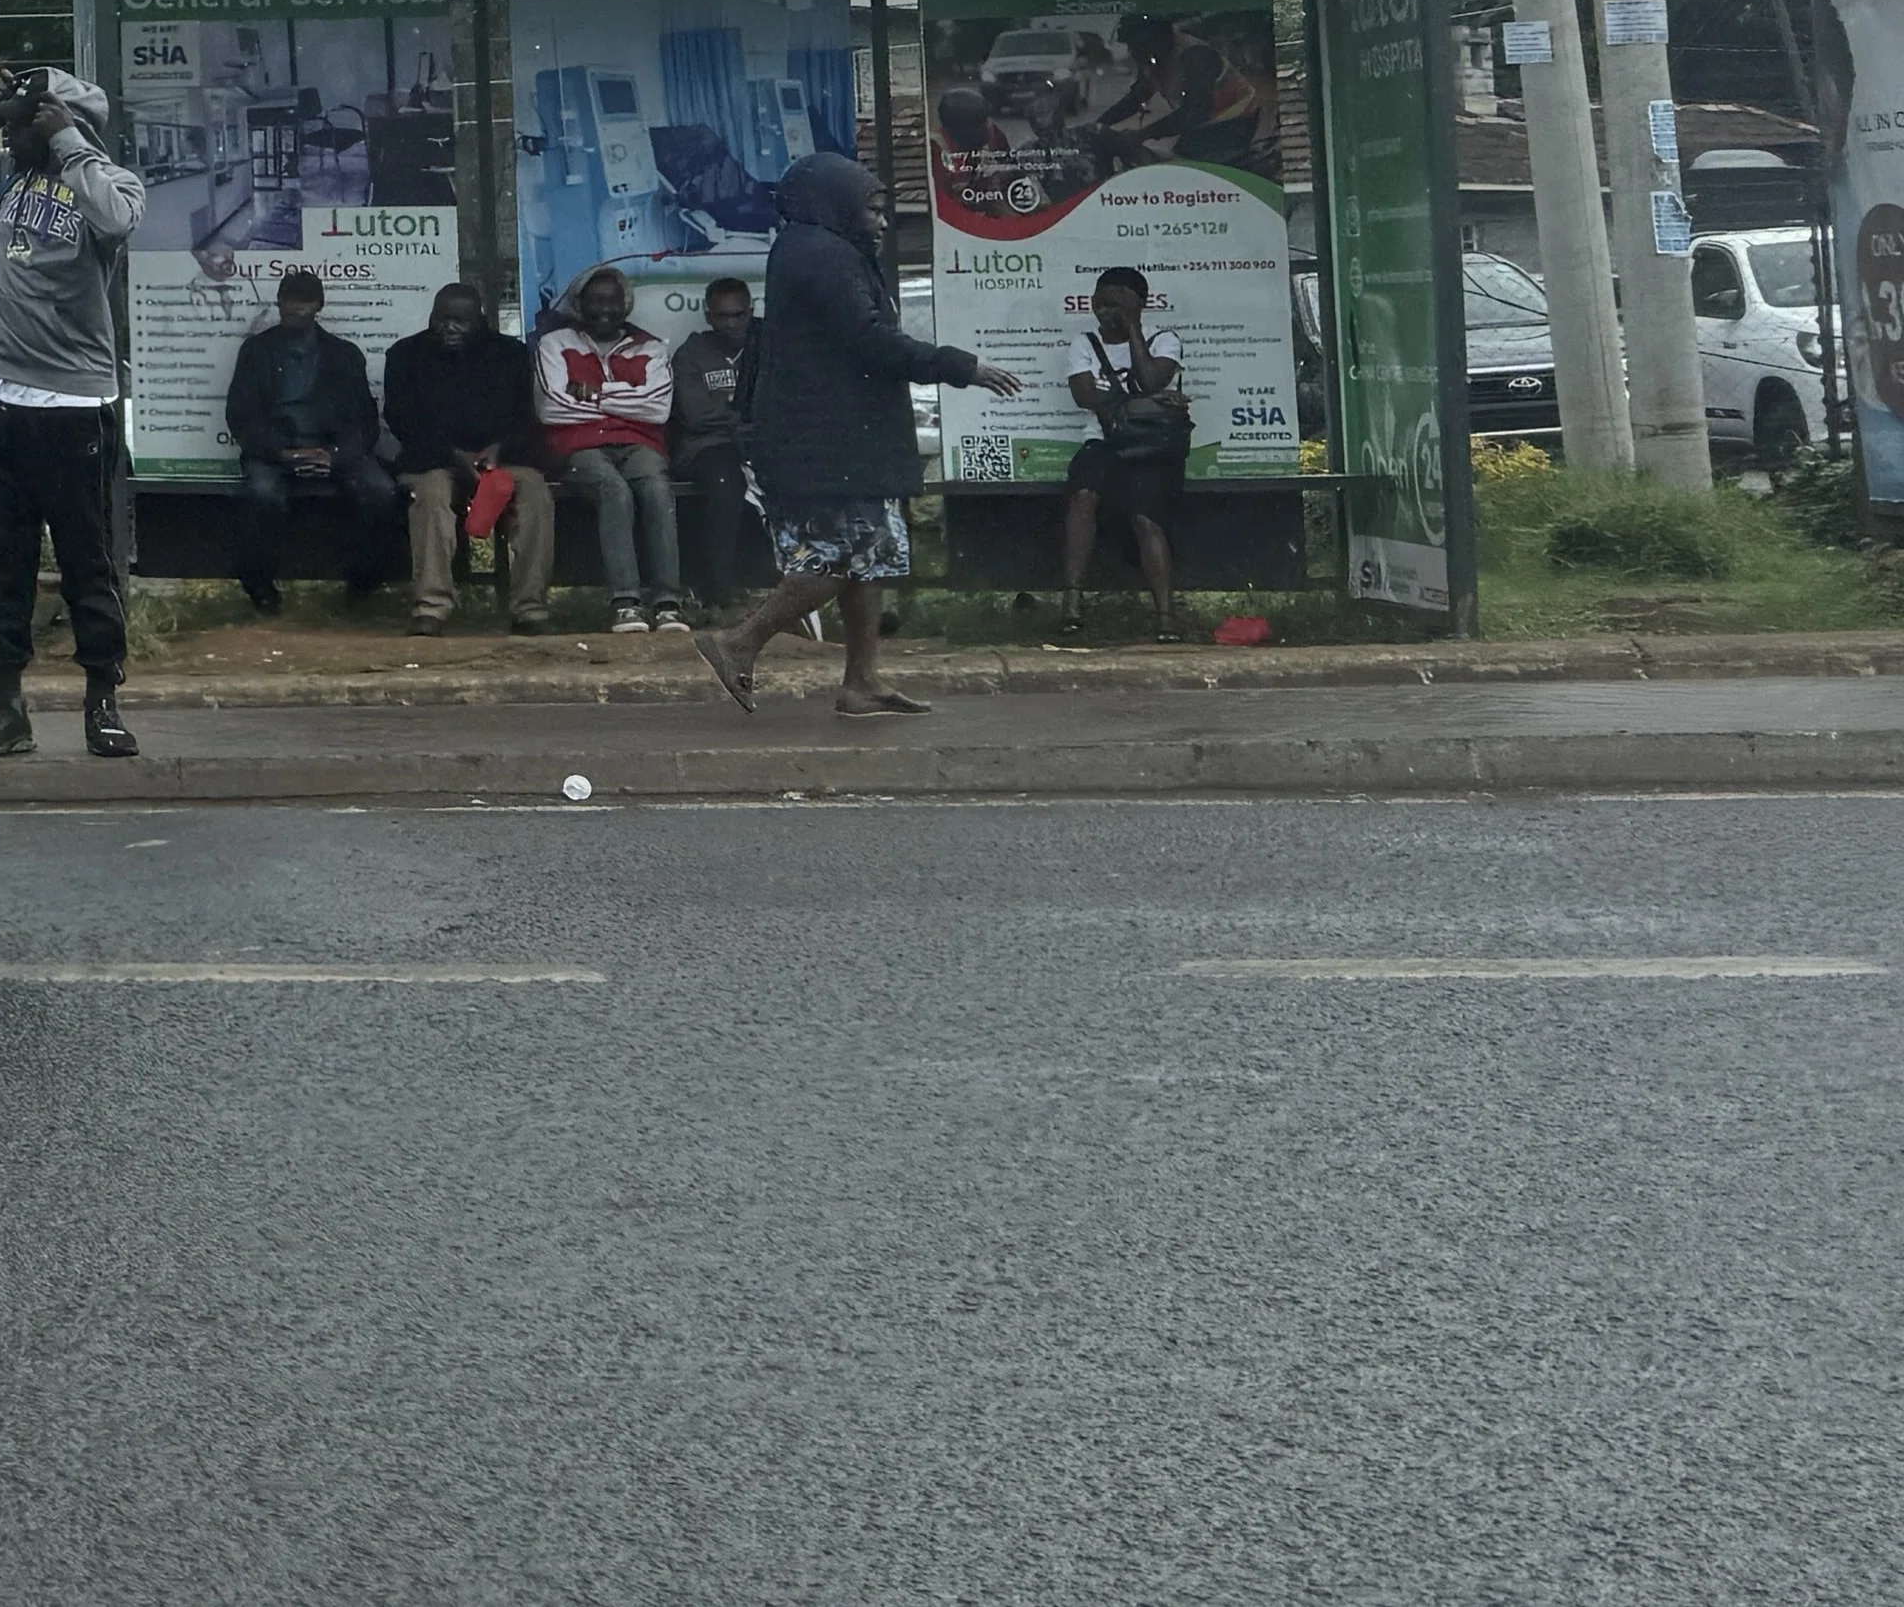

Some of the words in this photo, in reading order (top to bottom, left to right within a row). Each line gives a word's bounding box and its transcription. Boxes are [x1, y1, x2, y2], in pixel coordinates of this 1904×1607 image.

[962, 188, 1004, 203] Open
[1100, 192, 1137, 206] How
[1143, 192, 1159, 205] to
[1164, 190, 1242, 209] Register:
[321, 209, 440, 237] Luton
[356, 242, 441, 256] HOSPITAL
[946, 249, 1043, 275] Luton
[973, 277, 1043, 291] HOSPITAL
